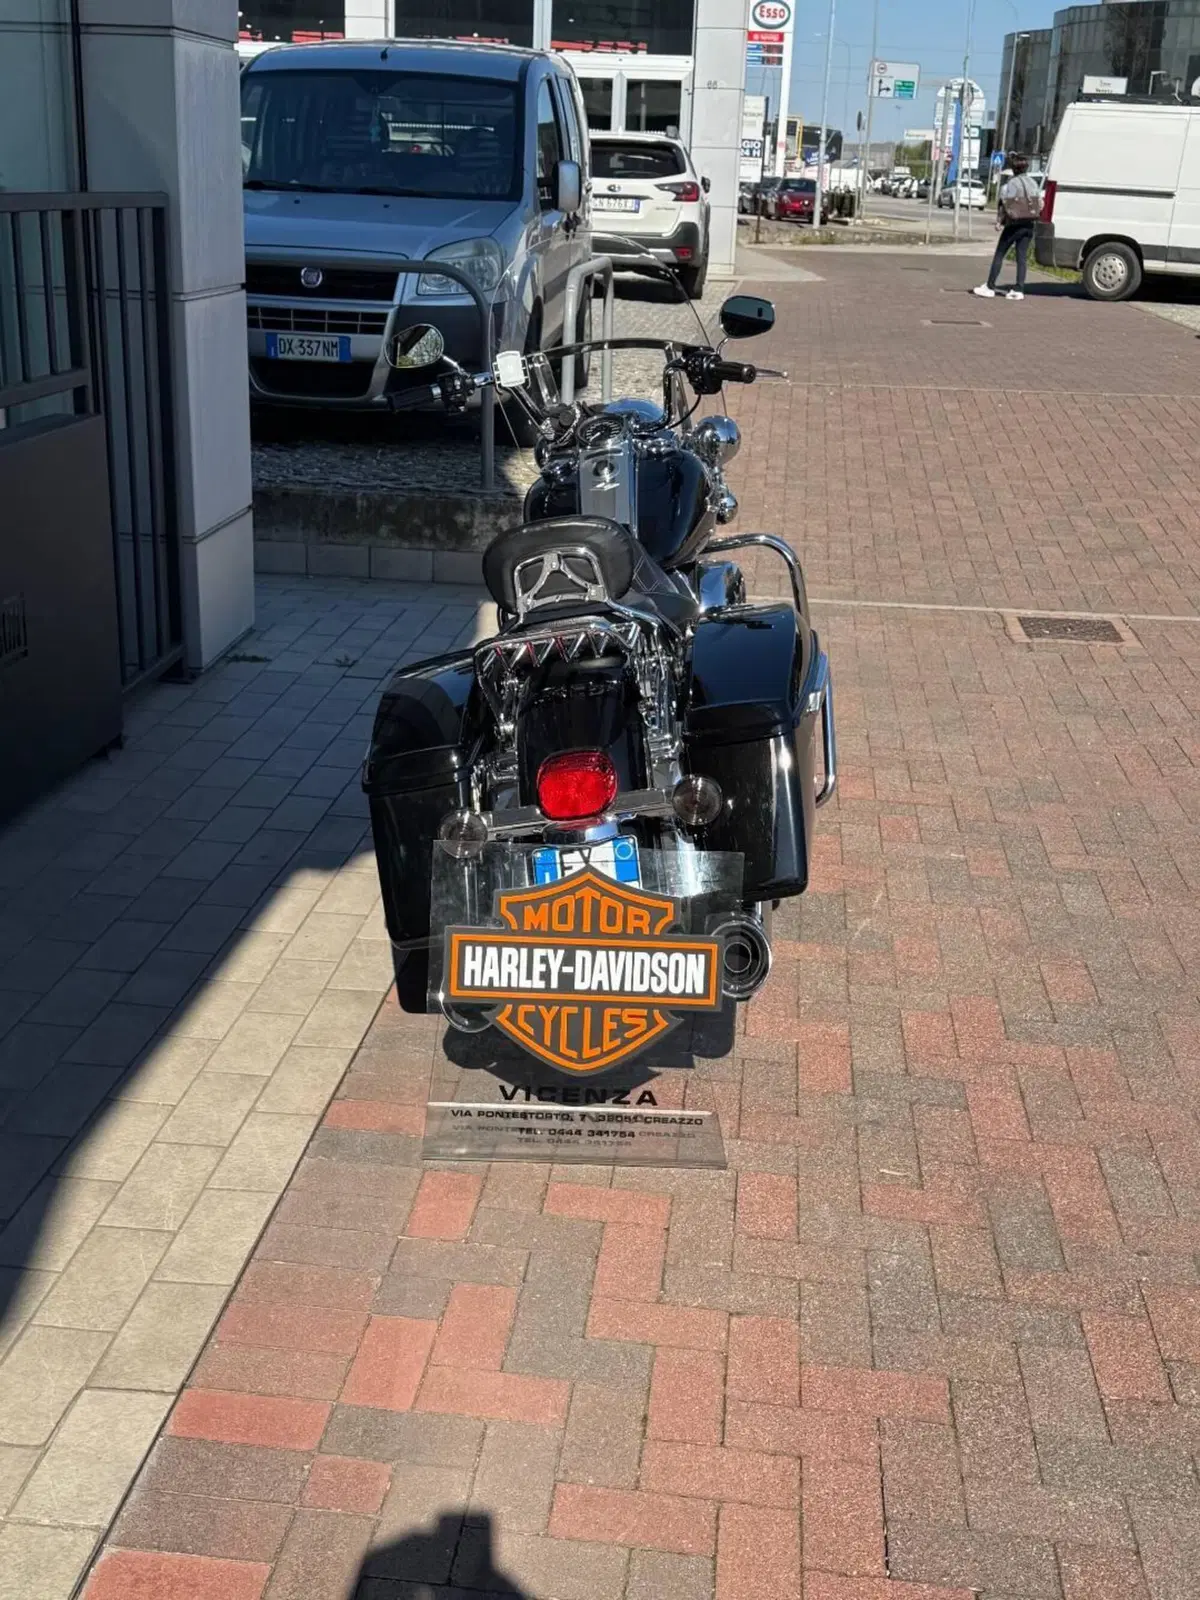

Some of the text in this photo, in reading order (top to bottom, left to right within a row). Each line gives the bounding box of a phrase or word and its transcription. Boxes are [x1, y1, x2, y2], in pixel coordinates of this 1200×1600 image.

[522, 886, 651, 936] MOTOR
[463, 945, 705, 995] HARLEY-DAVIDSON
[516, 1004, 649, 1060] CYCLES
[499, 1084, 659, 1106] VICENZA
[450, 1109, 473, 1118] VIA
[643, 1115, 703, 1126] CREAZZO
[548, 1128, 582, 1137] 0444
[587, 1129, 636, 1139] 341754
